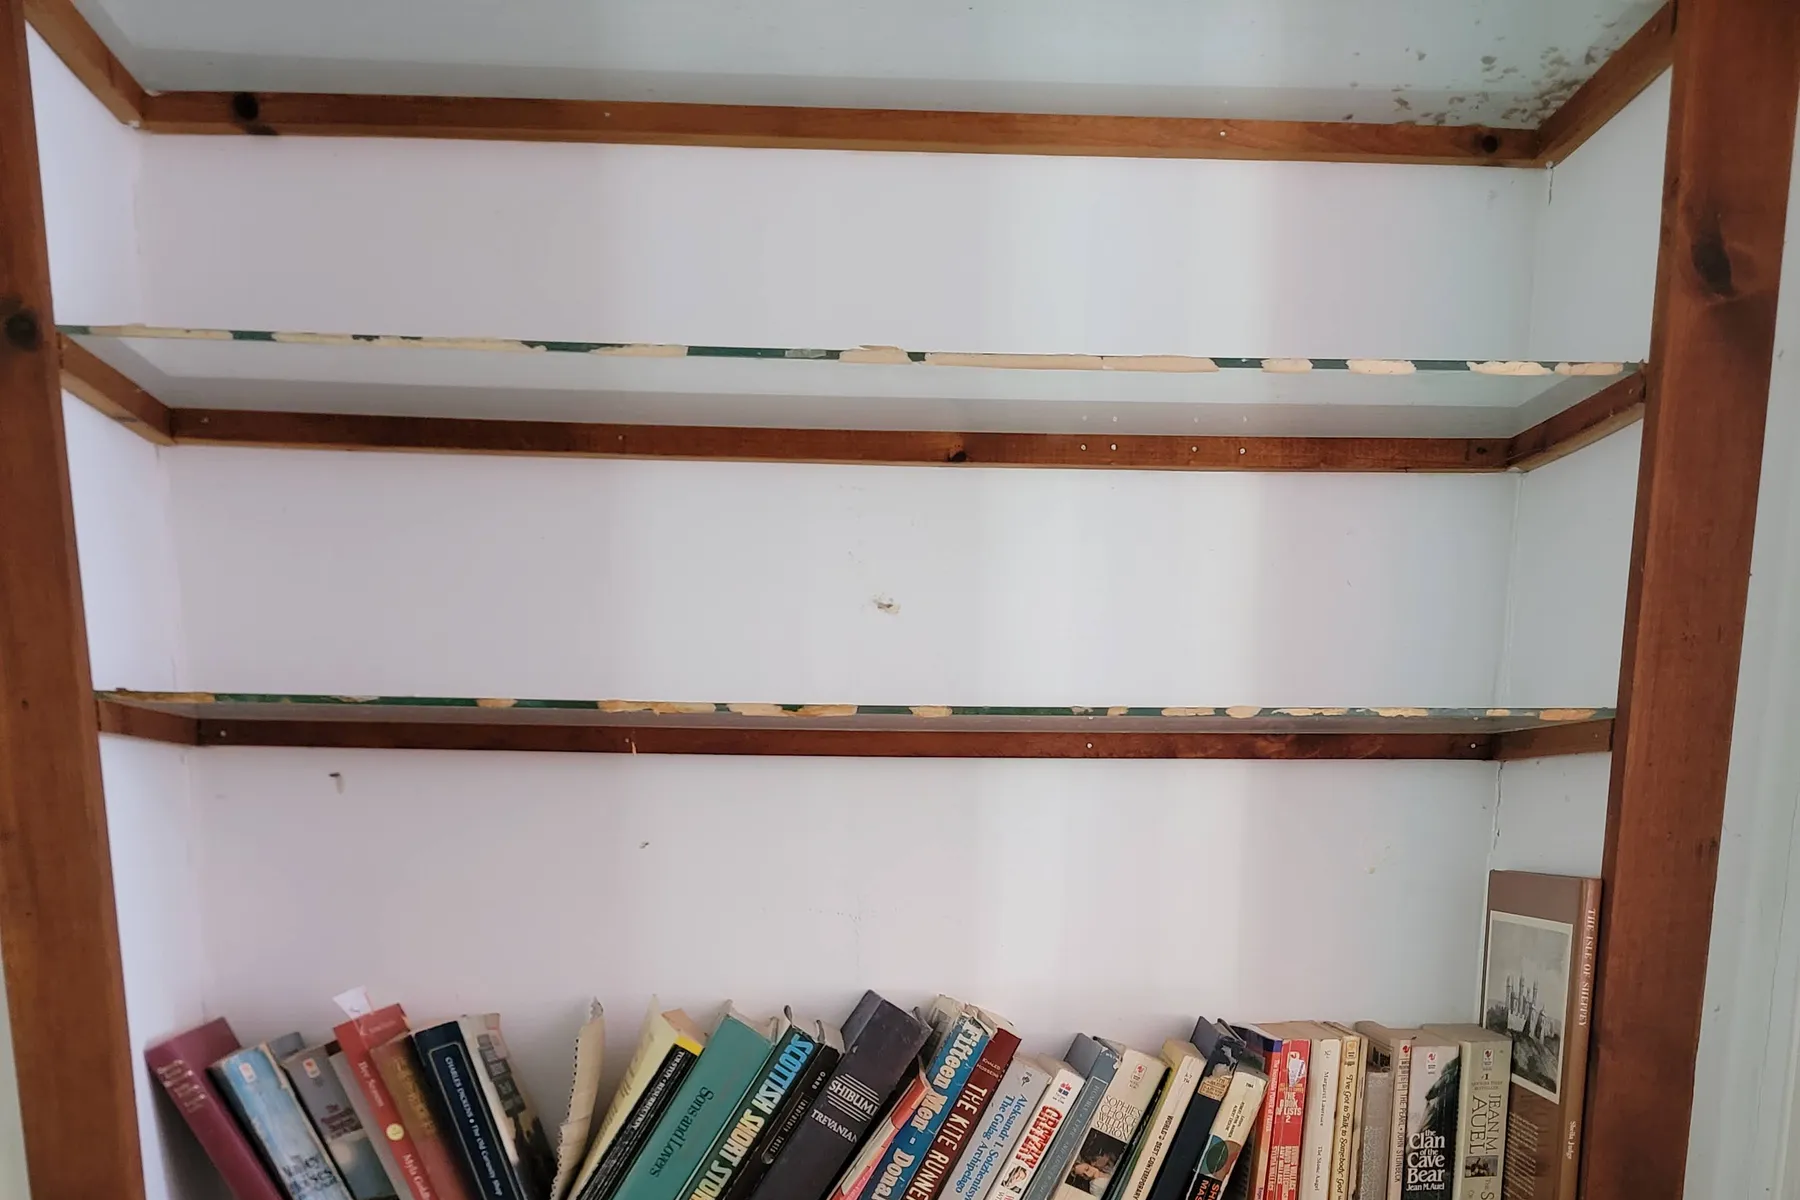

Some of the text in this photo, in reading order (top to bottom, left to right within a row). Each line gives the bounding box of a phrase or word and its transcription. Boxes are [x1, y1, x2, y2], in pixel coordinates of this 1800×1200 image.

[1575, 908, 1596, 1028] THE ISLE OF SHEPPEY
[750, 1032, 814, 1115] SCOTTISH
[931, 1019, 984, 1093] Fifteen
[357, 1060, 384, 1107] Bee Season
[444, 1055, 474, 1118] CHARLES DICKENS
[827, 1079, 879, 1116] SHIBUMI
[955, 1080, 987, 1115] THE
[1344, 1074, 1352, 1089] I've
[809, 1108, 860, 1144] TREVANIAN
[908, 1087, 948, 1135] Men
[936, 1111, 970, 1151] KITE
[996, 1093, 1029, 1142] Aleksandr
[1341, 1112, 1349, 1128] Talk
[1468, 1095, 1488, 1155] AUEL
[1485, 1093, 1501, 1154] JEAN M.
[648, 1085, 715, 1180] Sons and Lovers
[716, 1107, 766, 1168] SHORT
[952, 1092, 1015, 1195] The Gulag Archipelago
[991, 1140, 1003, 1150] I.
[1409, 1134, 1444, 1149] Clan
[1425, 1129, 1435, 1137] the
[401, 1152, 420, 1176] Myla
[470, 1124, 503, 1197] The Old Curiosity Shop
[1393, 1149, 1402, 1182] STEINBECK
[1407, 1154, 1444, 1167] Cave
[1407, 1168, 1444, 1183] Bear
[1336, 1177, 1344, 1193] God
